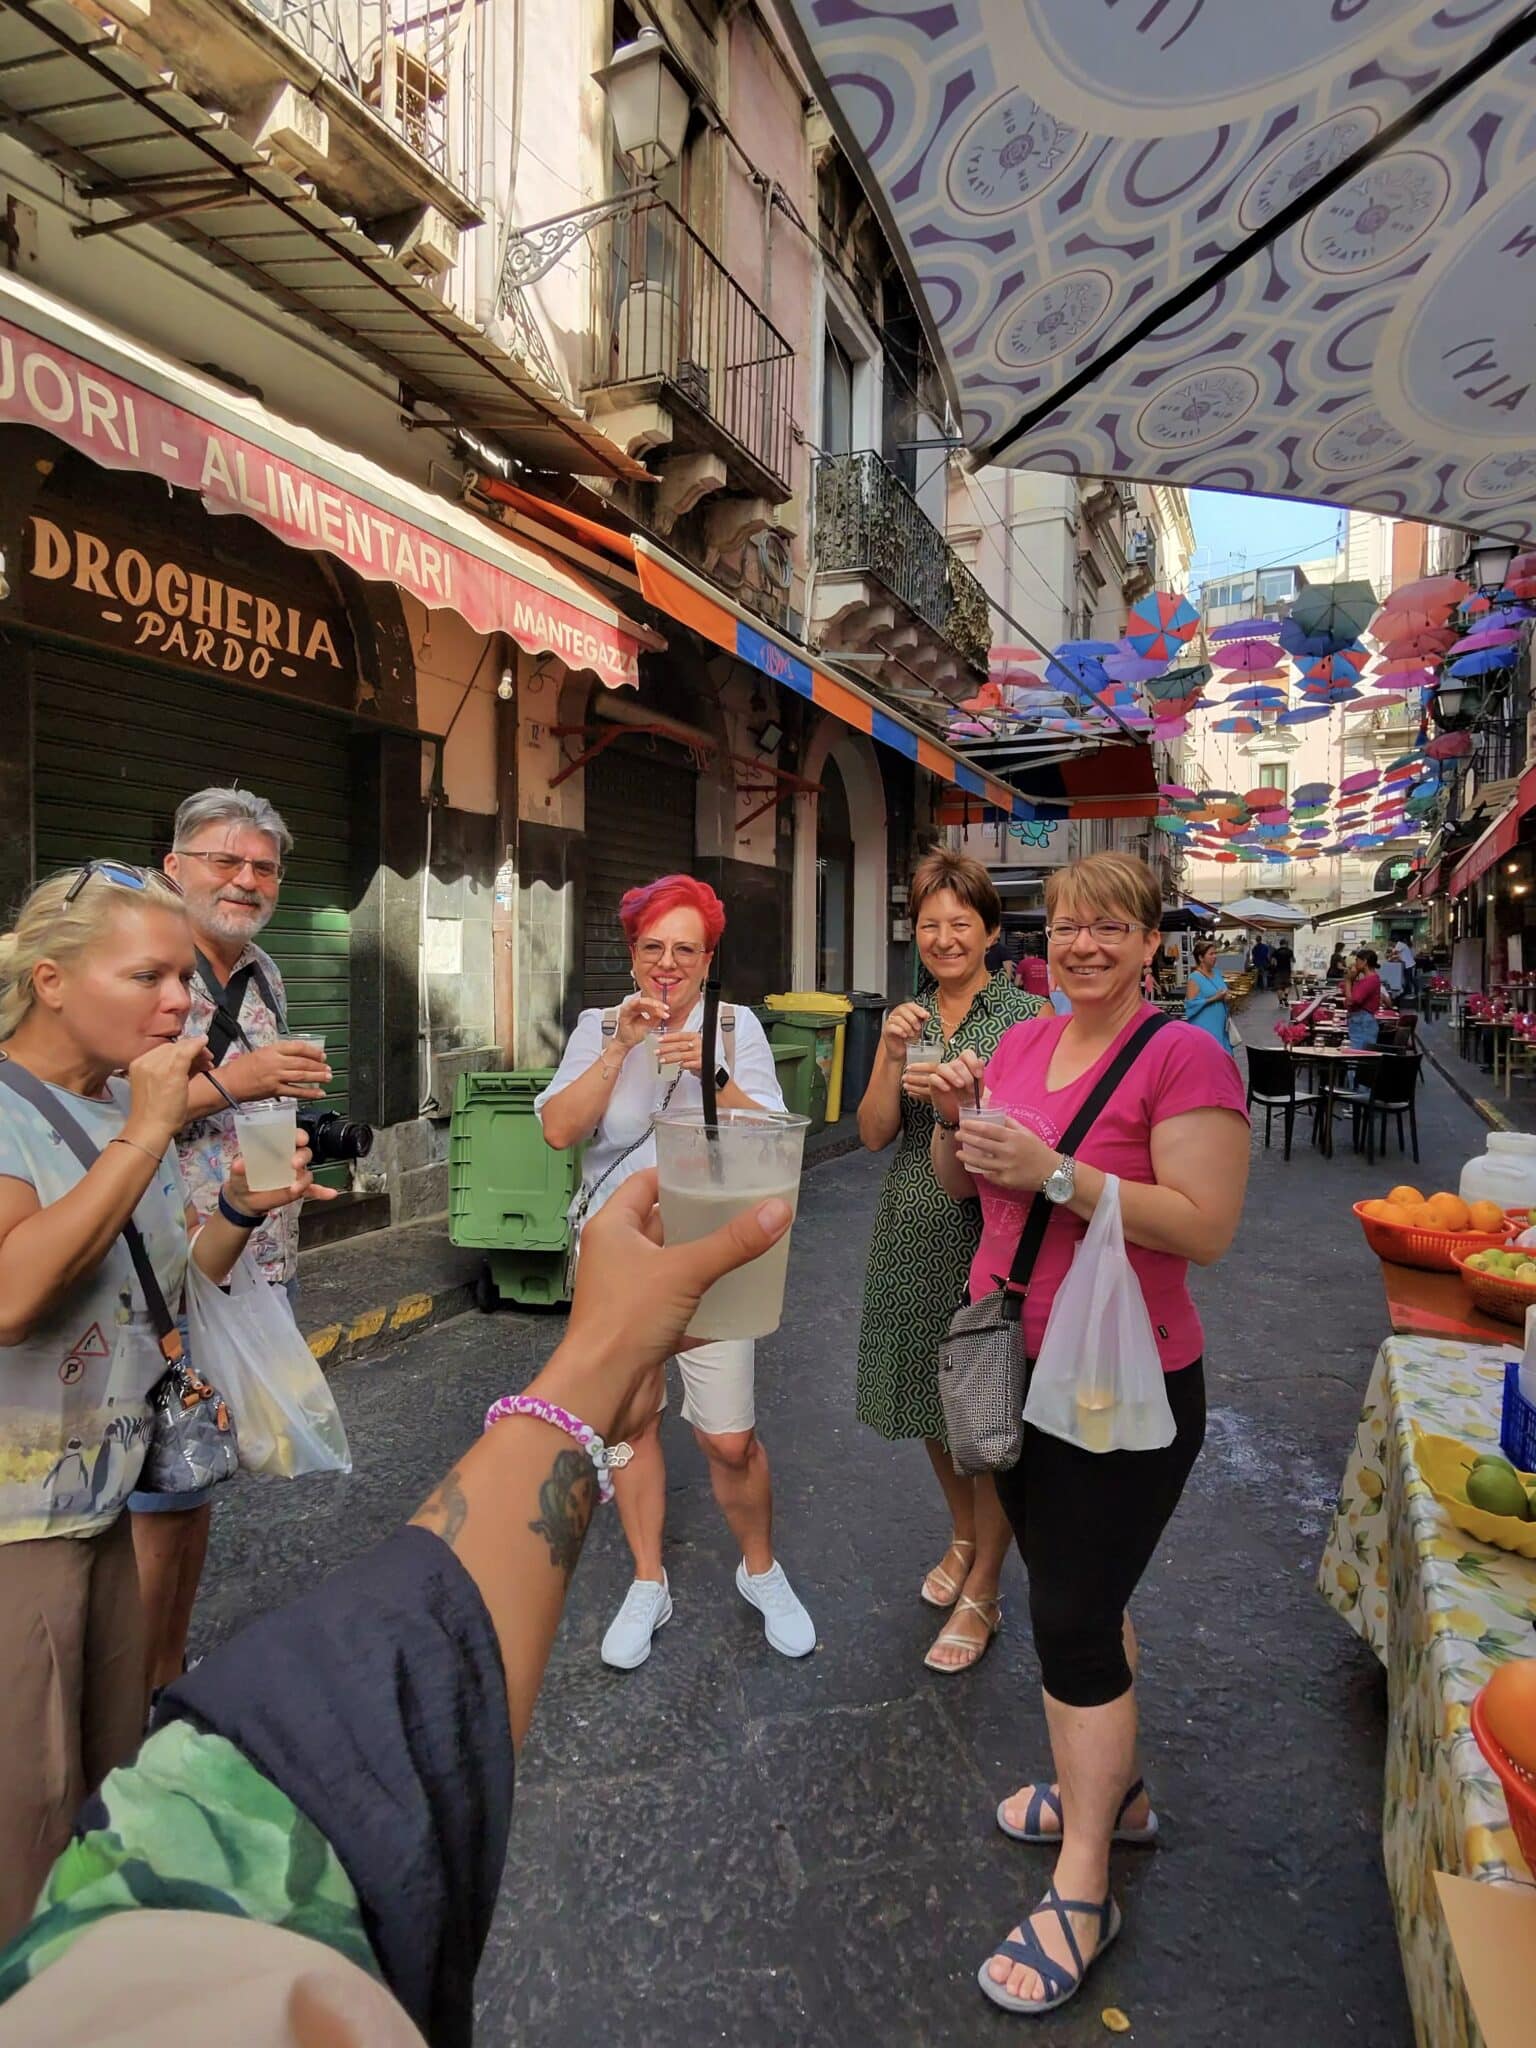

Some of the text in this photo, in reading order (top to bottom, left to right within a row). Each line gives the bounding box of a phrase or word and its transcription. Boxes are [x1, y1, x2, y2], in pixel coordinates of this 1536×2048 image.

[29, 515, 344, 669] DROGHERIA
[201, 437, 451, 599] ALIMENTARI
[134, 611, 275, 679] PARDO
